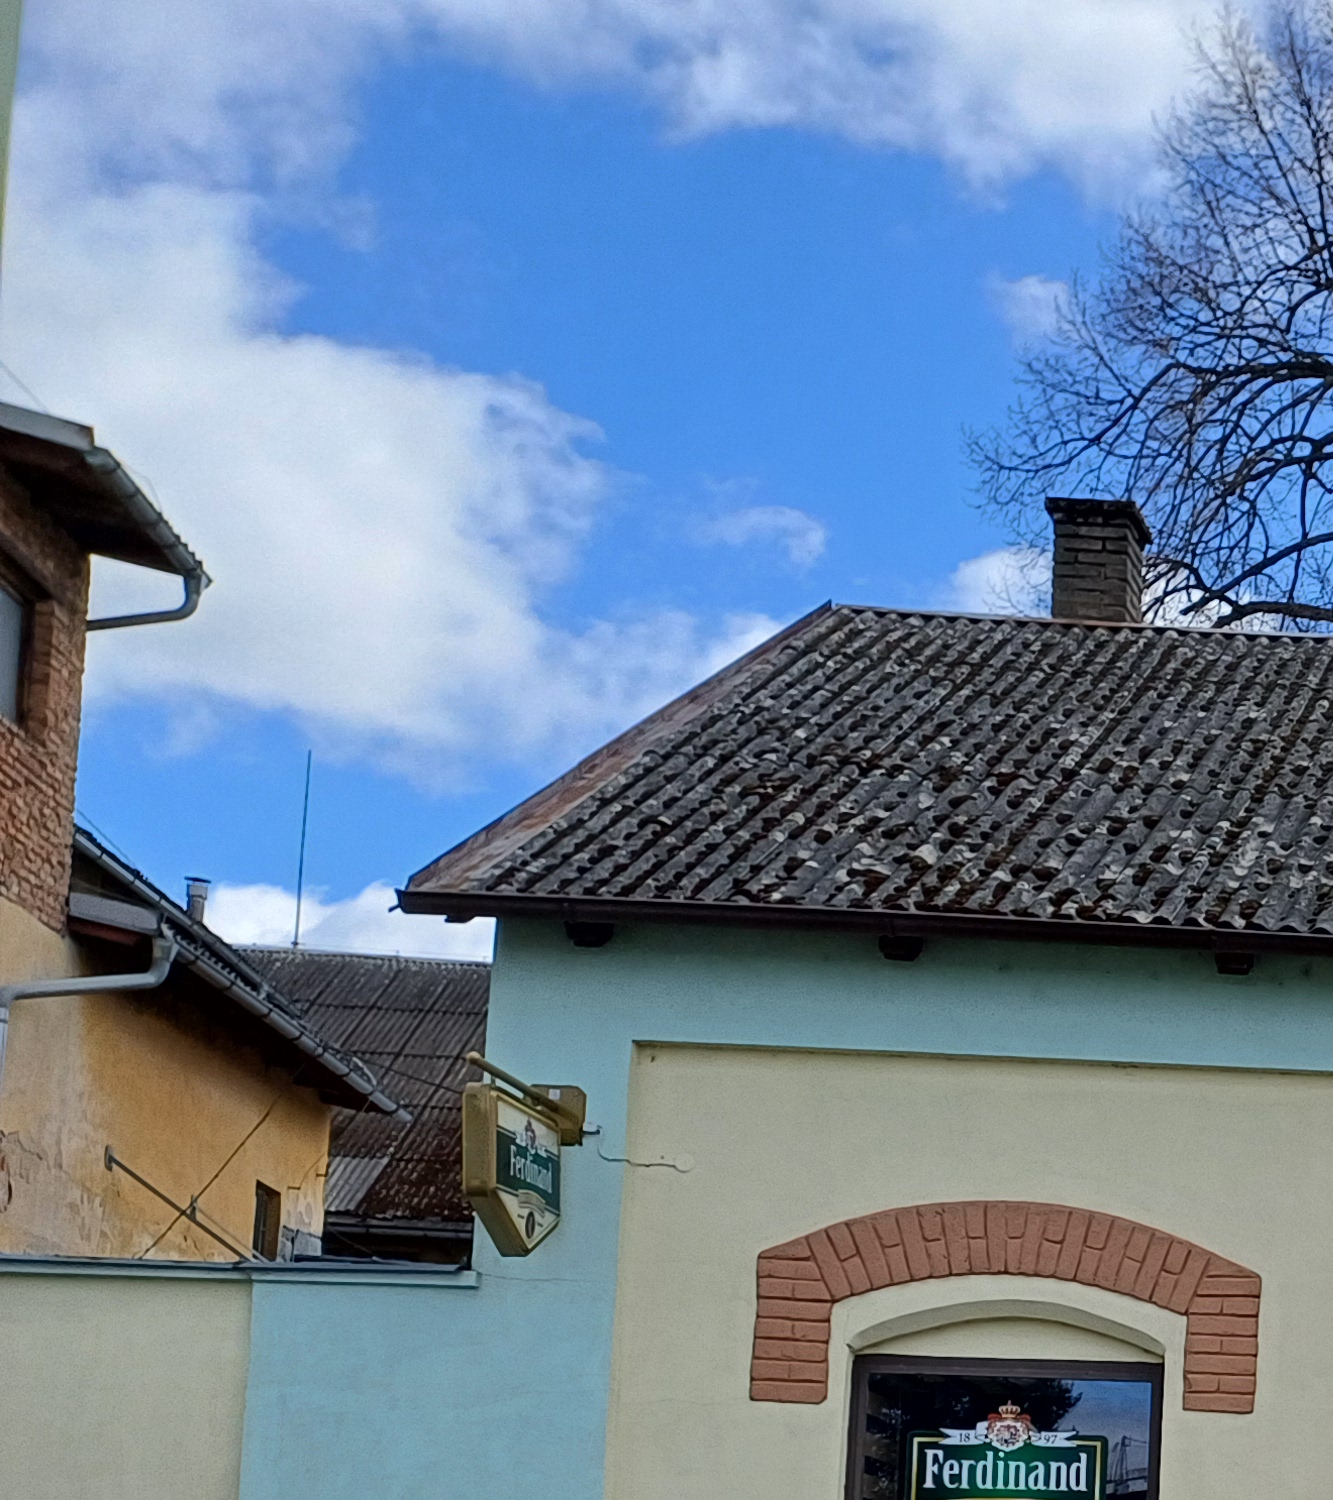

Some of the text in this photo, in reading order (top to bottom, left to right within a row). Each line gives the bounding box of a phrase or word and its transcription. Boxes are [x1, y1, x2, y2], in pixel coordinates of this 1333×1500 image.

[510, 1144, 553, 1194] Ferdinand
[958, 1432, 1058, 1445] 18 97
[922, 1448, 1089, 1492] Ferdinand
